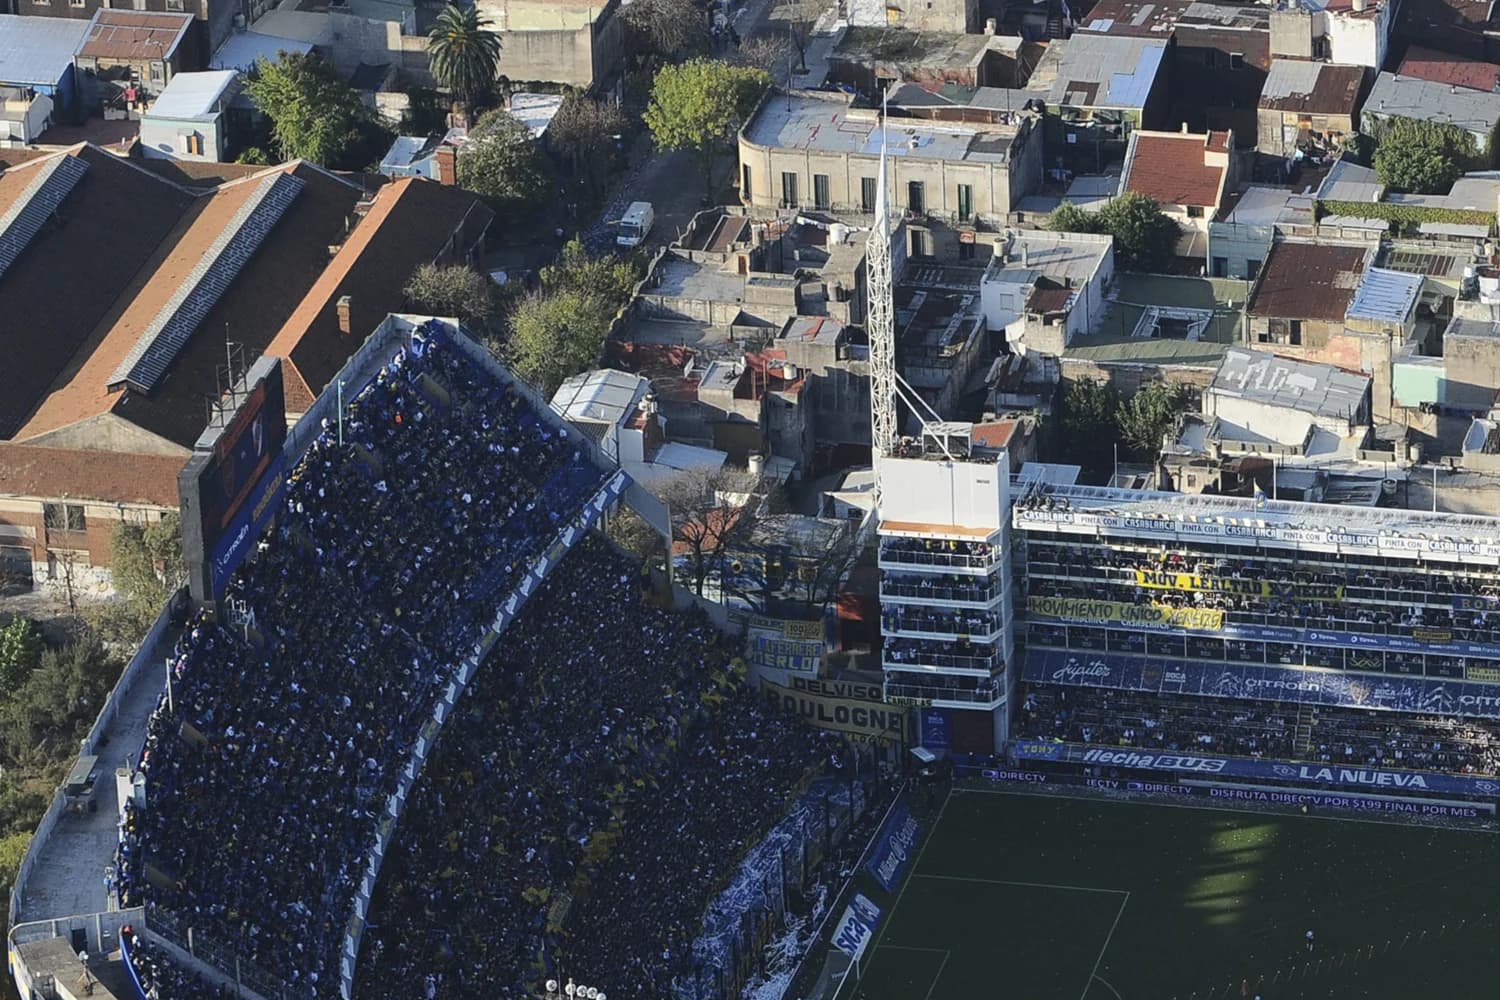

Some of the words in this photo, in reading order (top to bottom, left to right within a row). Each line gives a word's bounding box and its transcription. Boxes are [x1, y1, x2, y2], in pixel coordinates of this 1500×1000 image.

[1023, 511, 1074, 522] CASABLANCA
[1080, 516, 1100, 524] PINTA
[1103, 517, 1118, 526] CON
[1124, 519, 1175, 531] CASABLANCA
[1182, 524, 1203, 532] PINTA
[1205, 525, 1219, 533] CON
[1225, 526, 1277, 538] CASABLANCA
[1283, 531, 1304, 540] PINTA
[1306, 533, 1320, 541] CON
[1327, 534, 1377, 546] CASABLANCA
[1385, 539, 1405, 547] PINTA
[1407, 540, 1422, 548] CON
[1429, 541, 1480, 553] CASABLANCA
[1030, 599, 1113, 618] MOVIMIENTO
[766, 688, 901, 731] BOULOGNE
[1083, 749, 1154, 768] flecha
[1157, 757, 1226, 771] BUS
[1000, 772, 1046, 782] DIRECTV
[1300, 766, 1333, 780] LA
[1340, 769, 1429, 788] NUEVA
[1145, 783, 1192, 794] DIRECTV
[1210, 788, 1267, 801] DISFRUTA
[1325, 797, 1349, 808] POR
[1352, 799, 1381, 810] $199
[1385, 802, 1419, 813] FINAL
[1422, 805, 1447, 815] POR
[1451, 807, 1477, 817] MES
